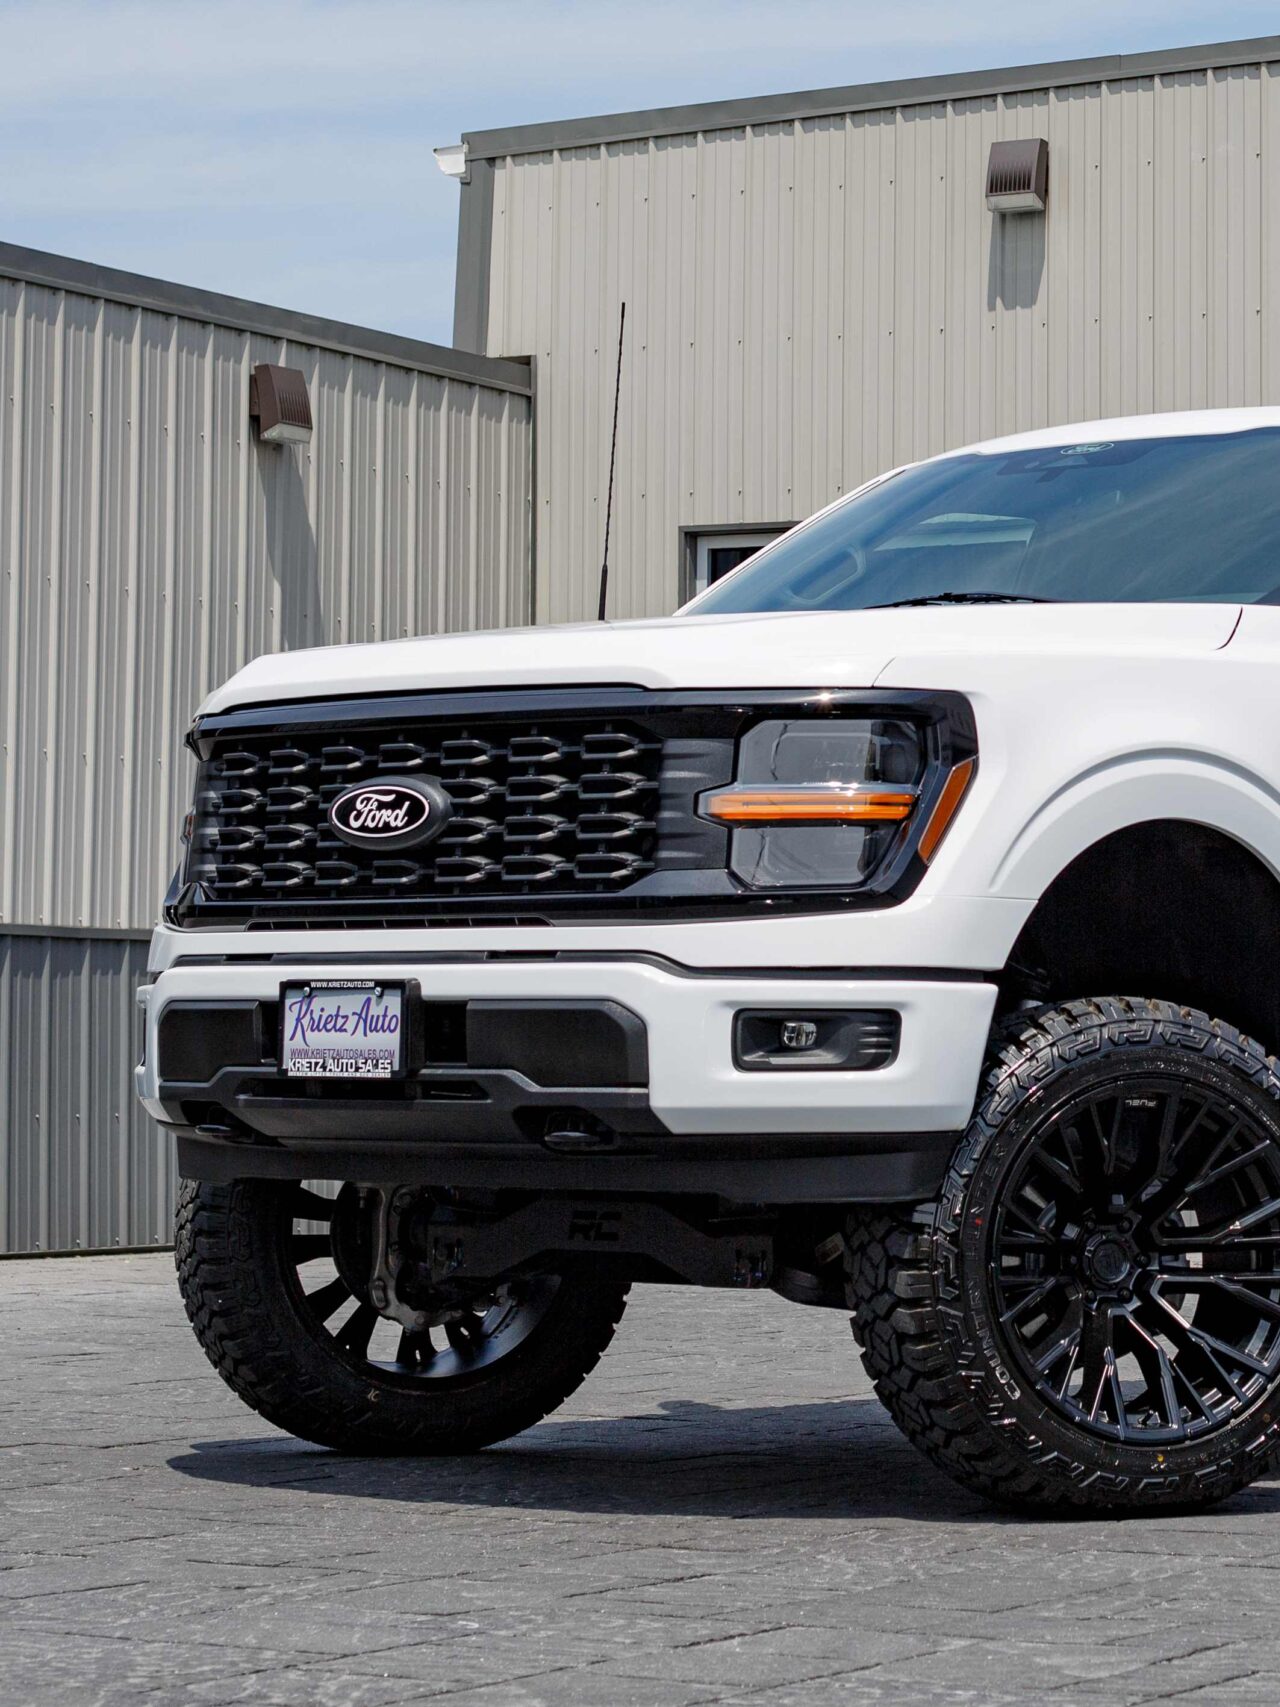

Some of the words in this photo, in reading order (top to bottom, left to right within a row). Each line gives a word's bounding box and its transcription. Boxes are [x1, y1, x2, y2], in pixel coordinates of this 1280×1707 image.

[349, 793, 411, 829] Ford
[289, 995, 349, 1047] Krietz
[351, 996, 399, 1037] Auto
[290, 1048, 395, 1059] WWW.KRIETZAUTOSALES.COM
[326, 1059, 356, 1072] AUTO
